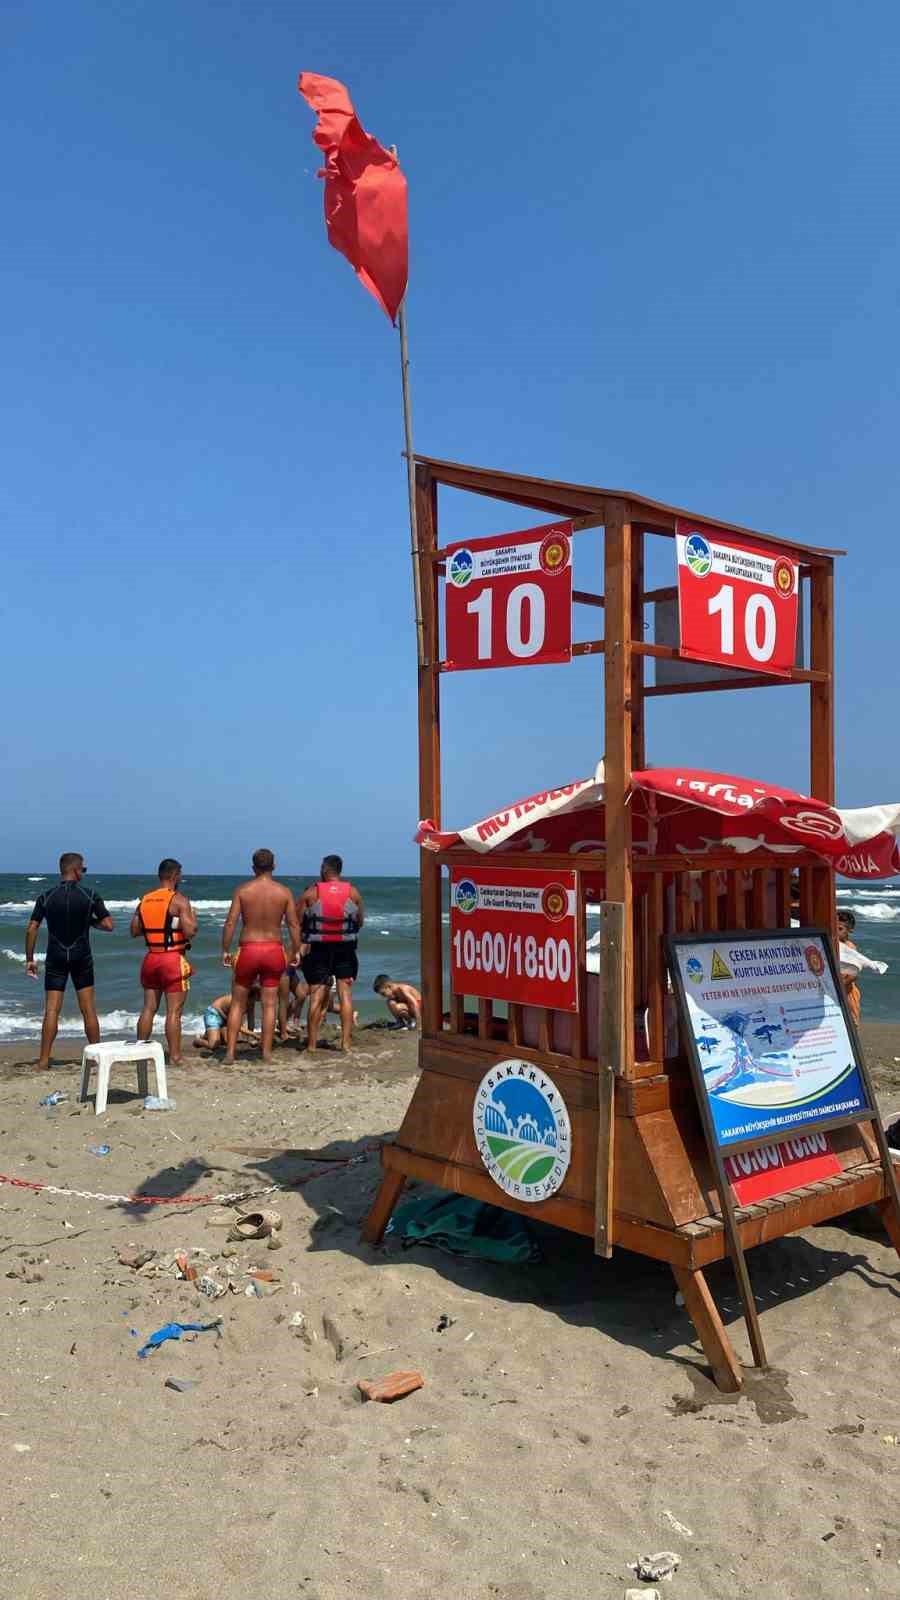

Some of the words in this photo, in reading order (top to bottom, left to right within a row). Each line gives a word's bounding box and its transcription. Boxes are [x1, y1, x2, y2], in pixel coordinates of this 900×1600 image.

[467, 583, 546, 660] 10
[708, 584, 777, 662] 10
[453, 929, 571, 983] 10:00/18:00
[728, 948, 758, 964] ÇEKEN
[759, 944, 802, 961] AKINTIDAN
[488, 1066, 554, 1103] SAKARYA
